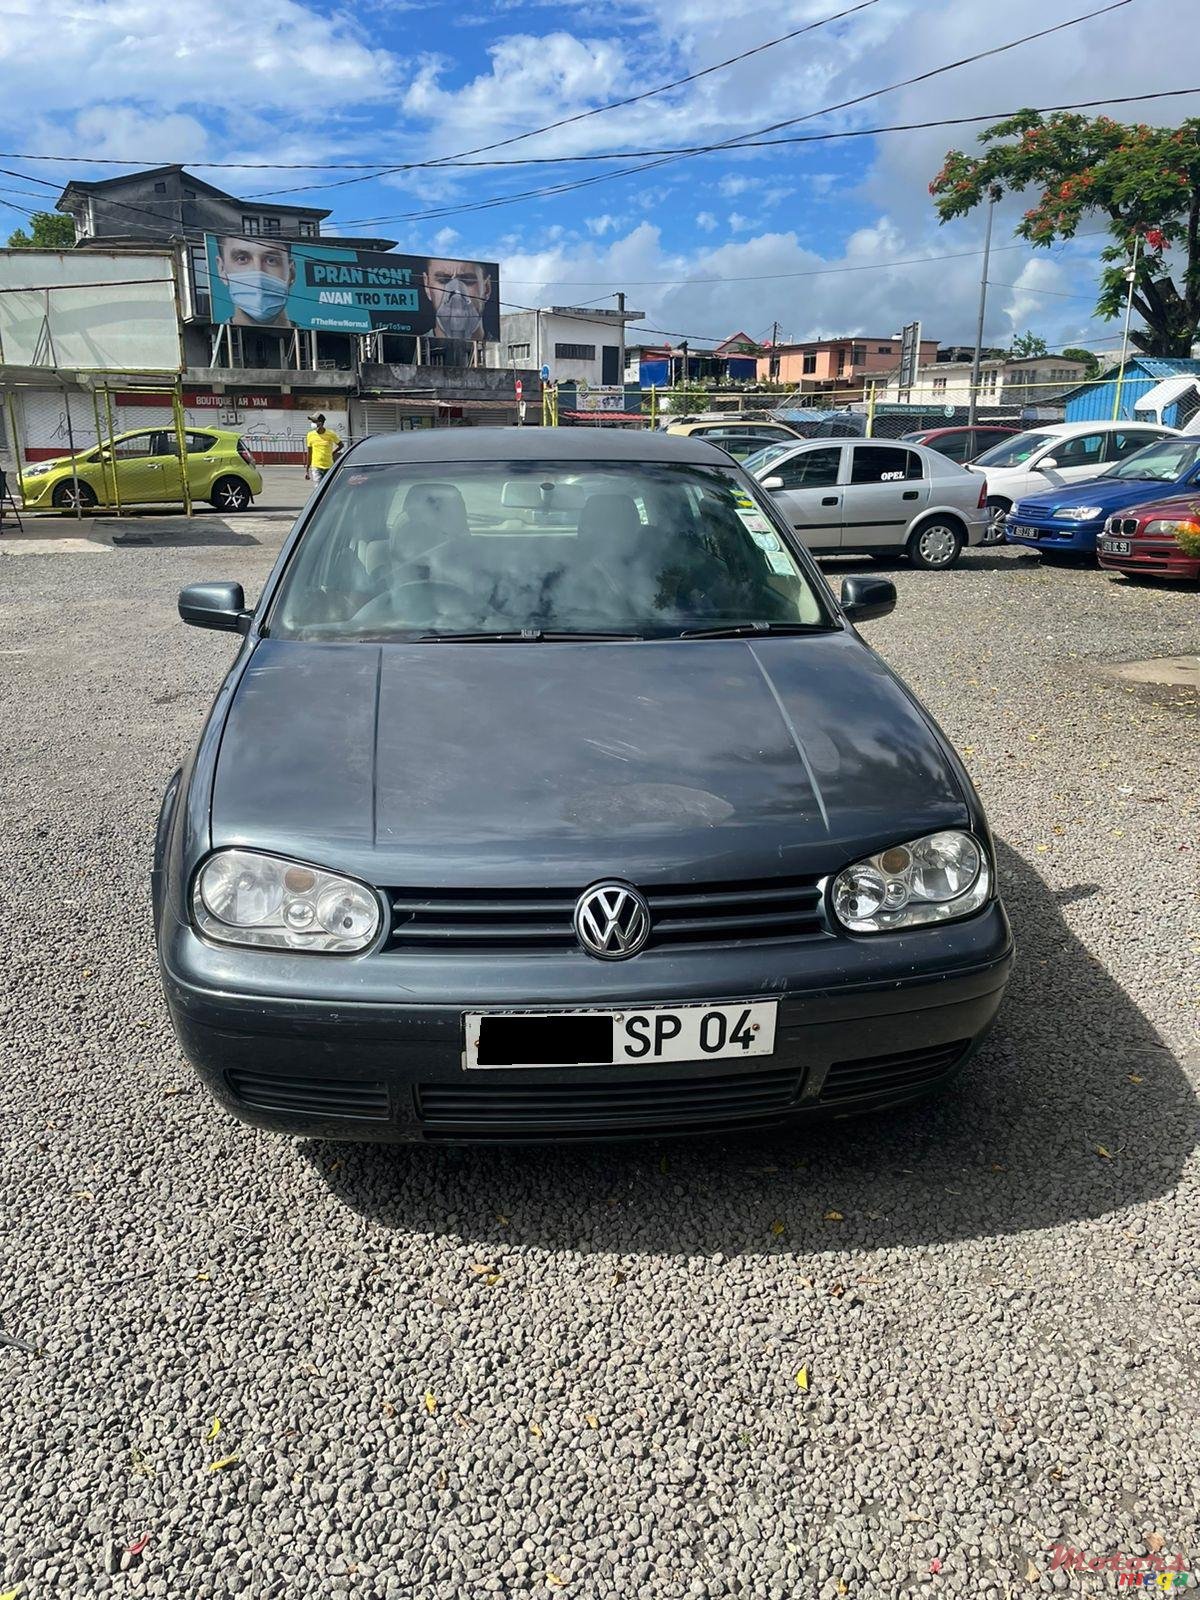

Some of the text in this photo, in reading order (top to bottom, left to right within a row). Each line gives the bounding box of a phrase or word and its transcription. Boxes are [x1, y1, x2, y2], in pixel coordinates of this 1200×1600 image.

[313, 265, 412, 286] PRAN KONT
[319, 291, 353, 305] AVAN
[355, 292, 380, 305] TRO
[383, 292, 408, 306] TAR
[310, 317, 369, 328] #TheNewNormal
[196, 396, 232, 407] BOUTIQUE
[252, 397, 268, 407] YAM
[880, 471, 905, 481] OPEL
[624, 1009, 756, 1058] SP 04
